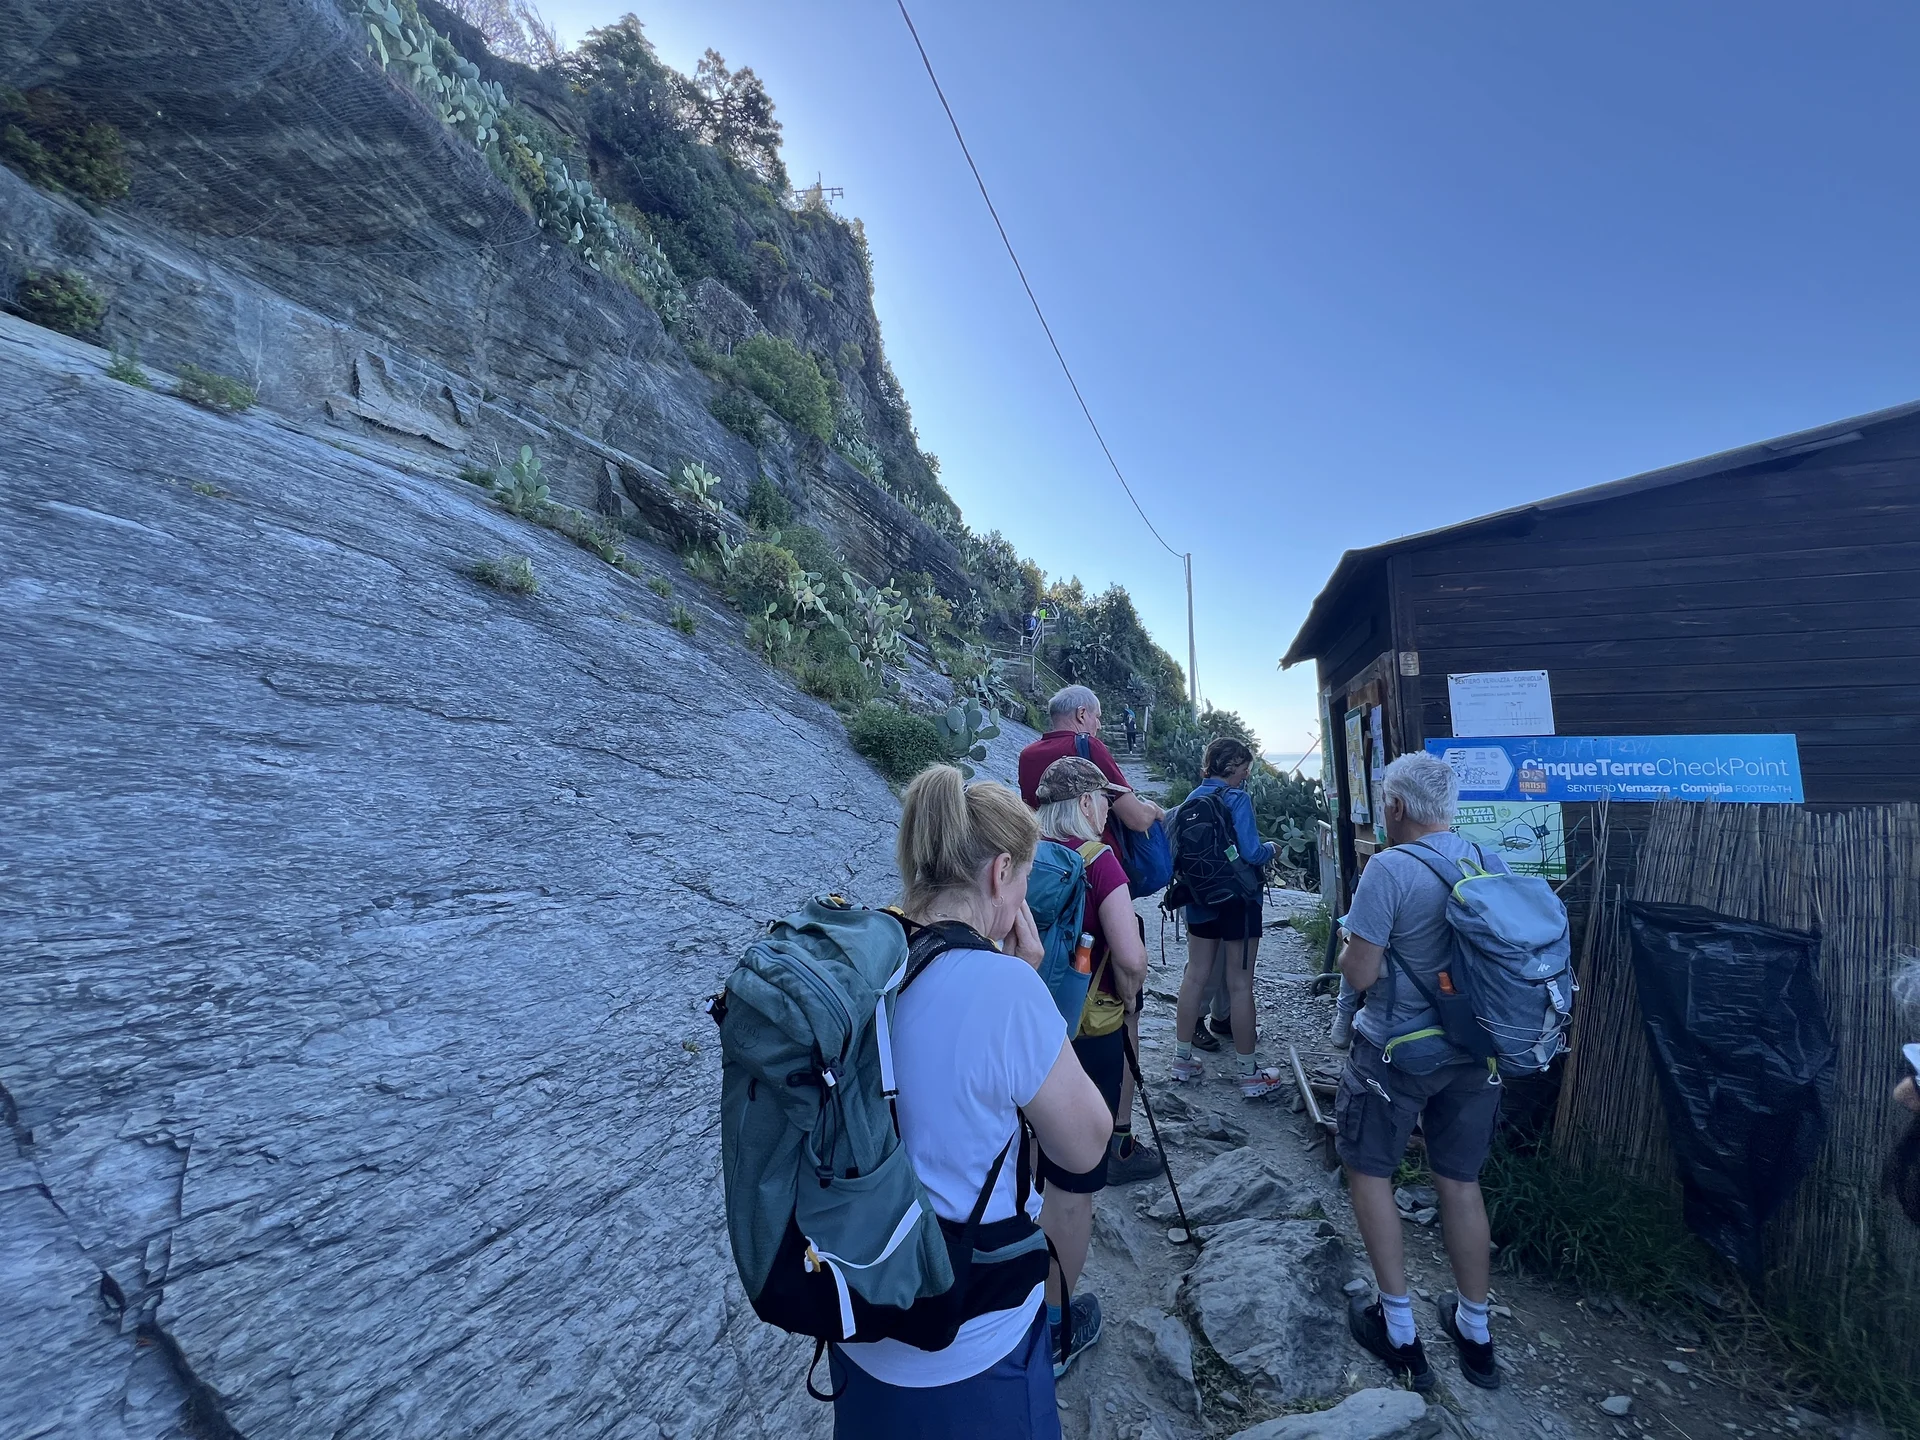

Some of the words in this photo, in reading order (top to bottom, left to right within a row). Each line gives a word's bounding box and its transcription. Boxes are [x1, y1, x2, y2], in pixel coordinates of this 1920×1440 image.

[1567, 784, 1616, 793] SENTIERO
[1617, 783, 1670, 793] Vernazza
[1680, 782, 1733, 795] Corniglia
[1735, 784, 1792, 794] FOOTPATH
[1472, 815, 1495, 823] FREE
